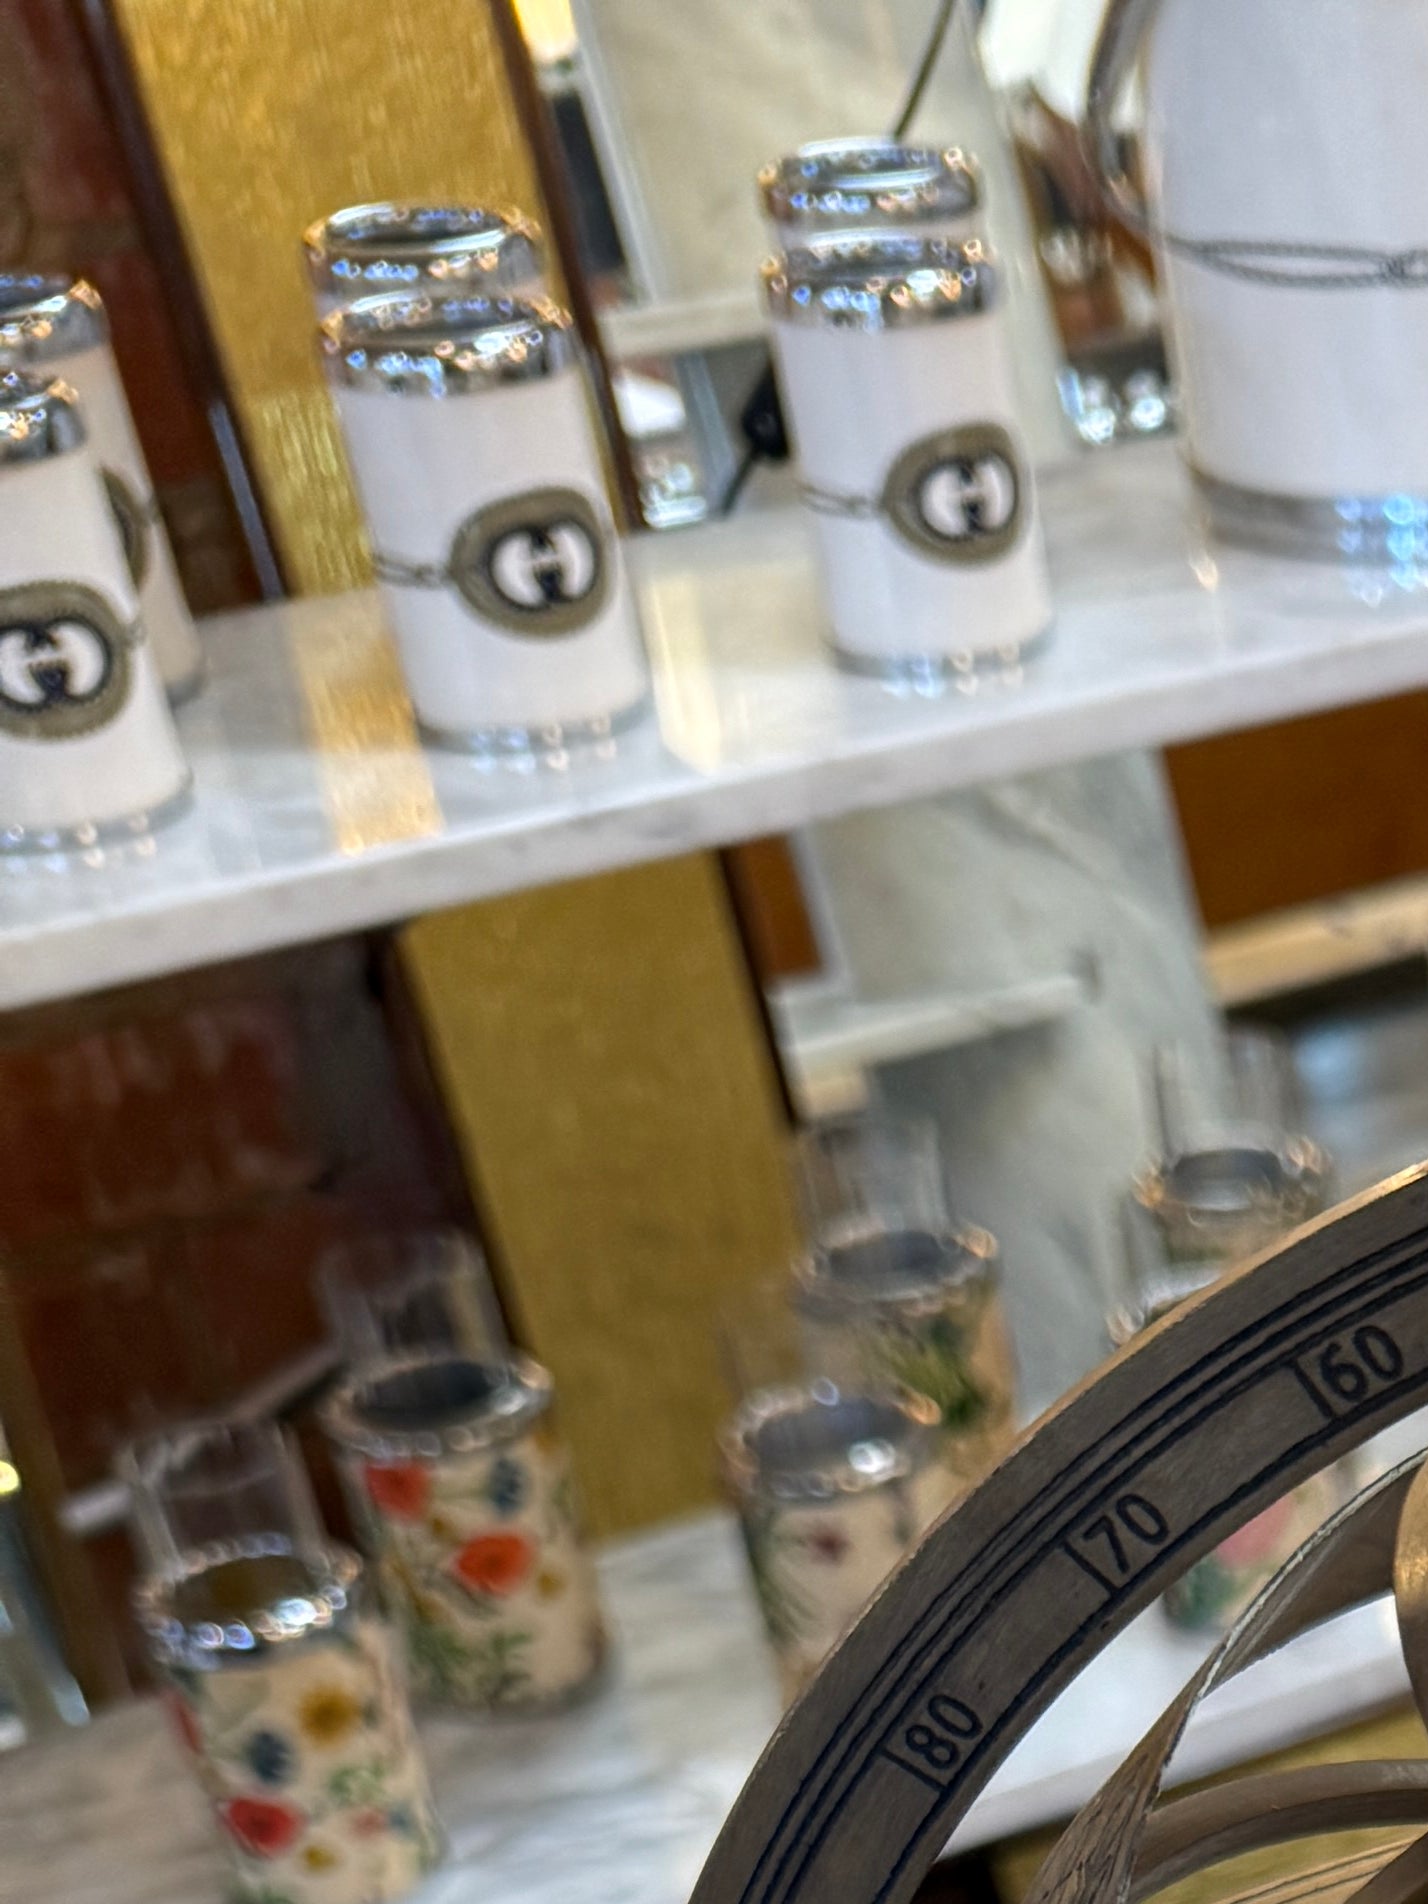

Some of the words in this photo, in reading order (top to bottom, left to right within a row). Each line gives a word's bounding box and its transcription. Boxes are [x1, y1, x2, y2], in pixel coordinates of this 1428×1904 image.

[1317, 1323, 1405, 1406] 60
[1090, 1492, 1170, 1576] 70
[905, 1692, 985, 1772] 80
